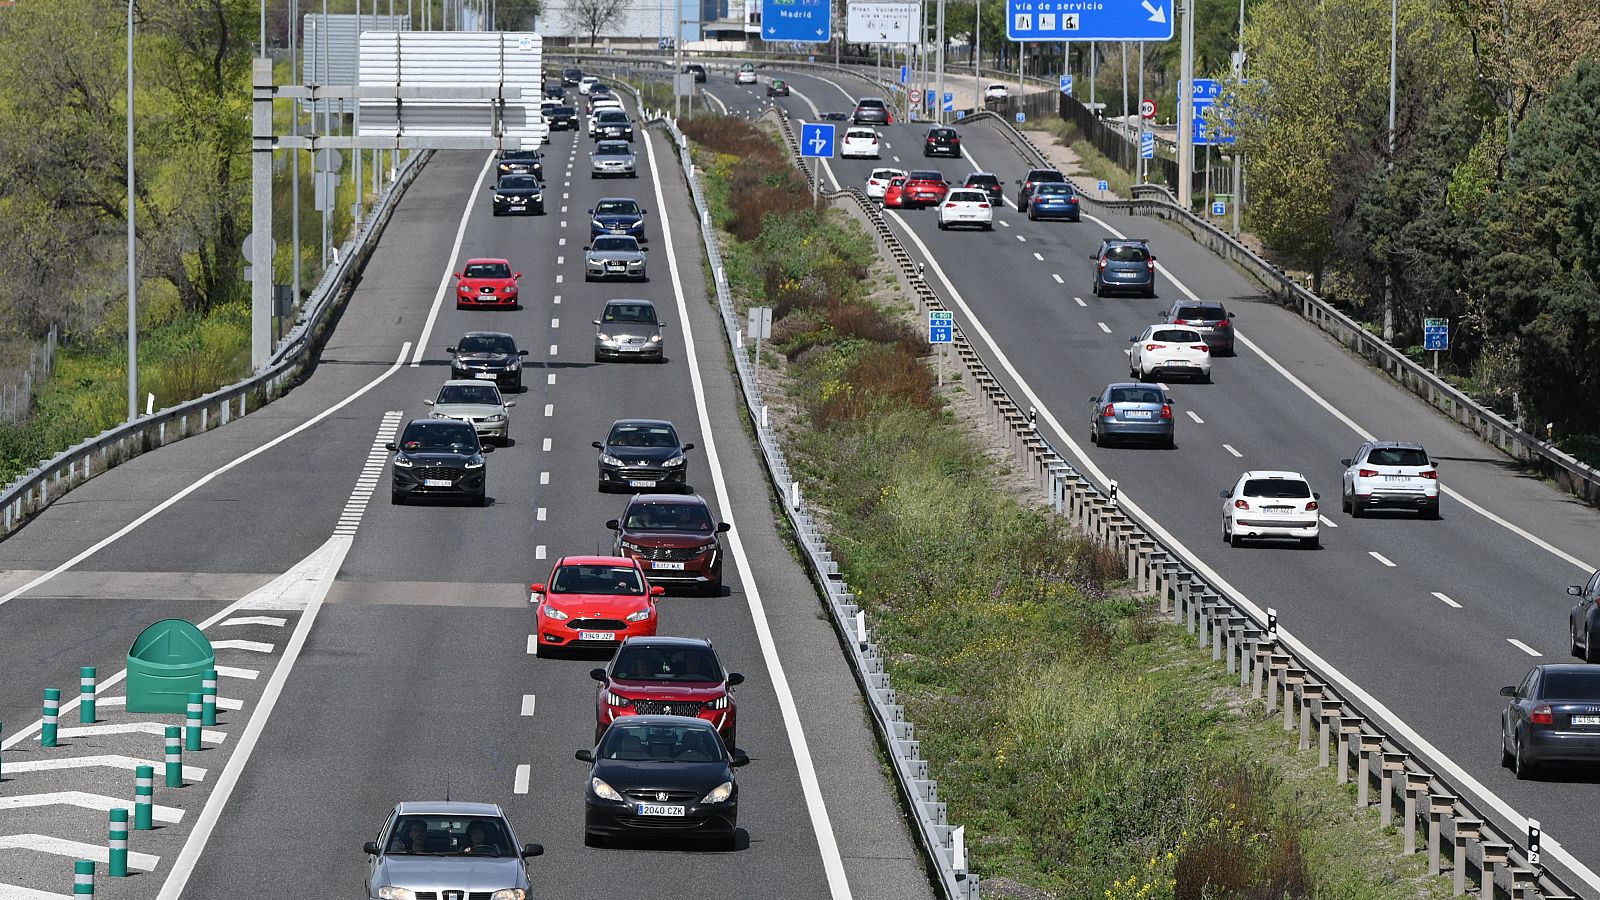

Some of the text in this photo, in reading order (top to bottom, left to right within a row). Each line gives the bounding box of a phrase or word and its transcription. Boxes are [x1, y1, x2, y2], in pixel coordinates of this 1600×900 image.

[1038, 2, 1051, 10] de
[1056, 2, 1104, 10] servicio
[780, 10, 812, 18] Madrid
[936, 333, 946, 341] 19
[1431, 340, 1441, 348] 19
[644, 806, 683, 815] 2040 CZK
[1531, 853, 1537, 862] 2
